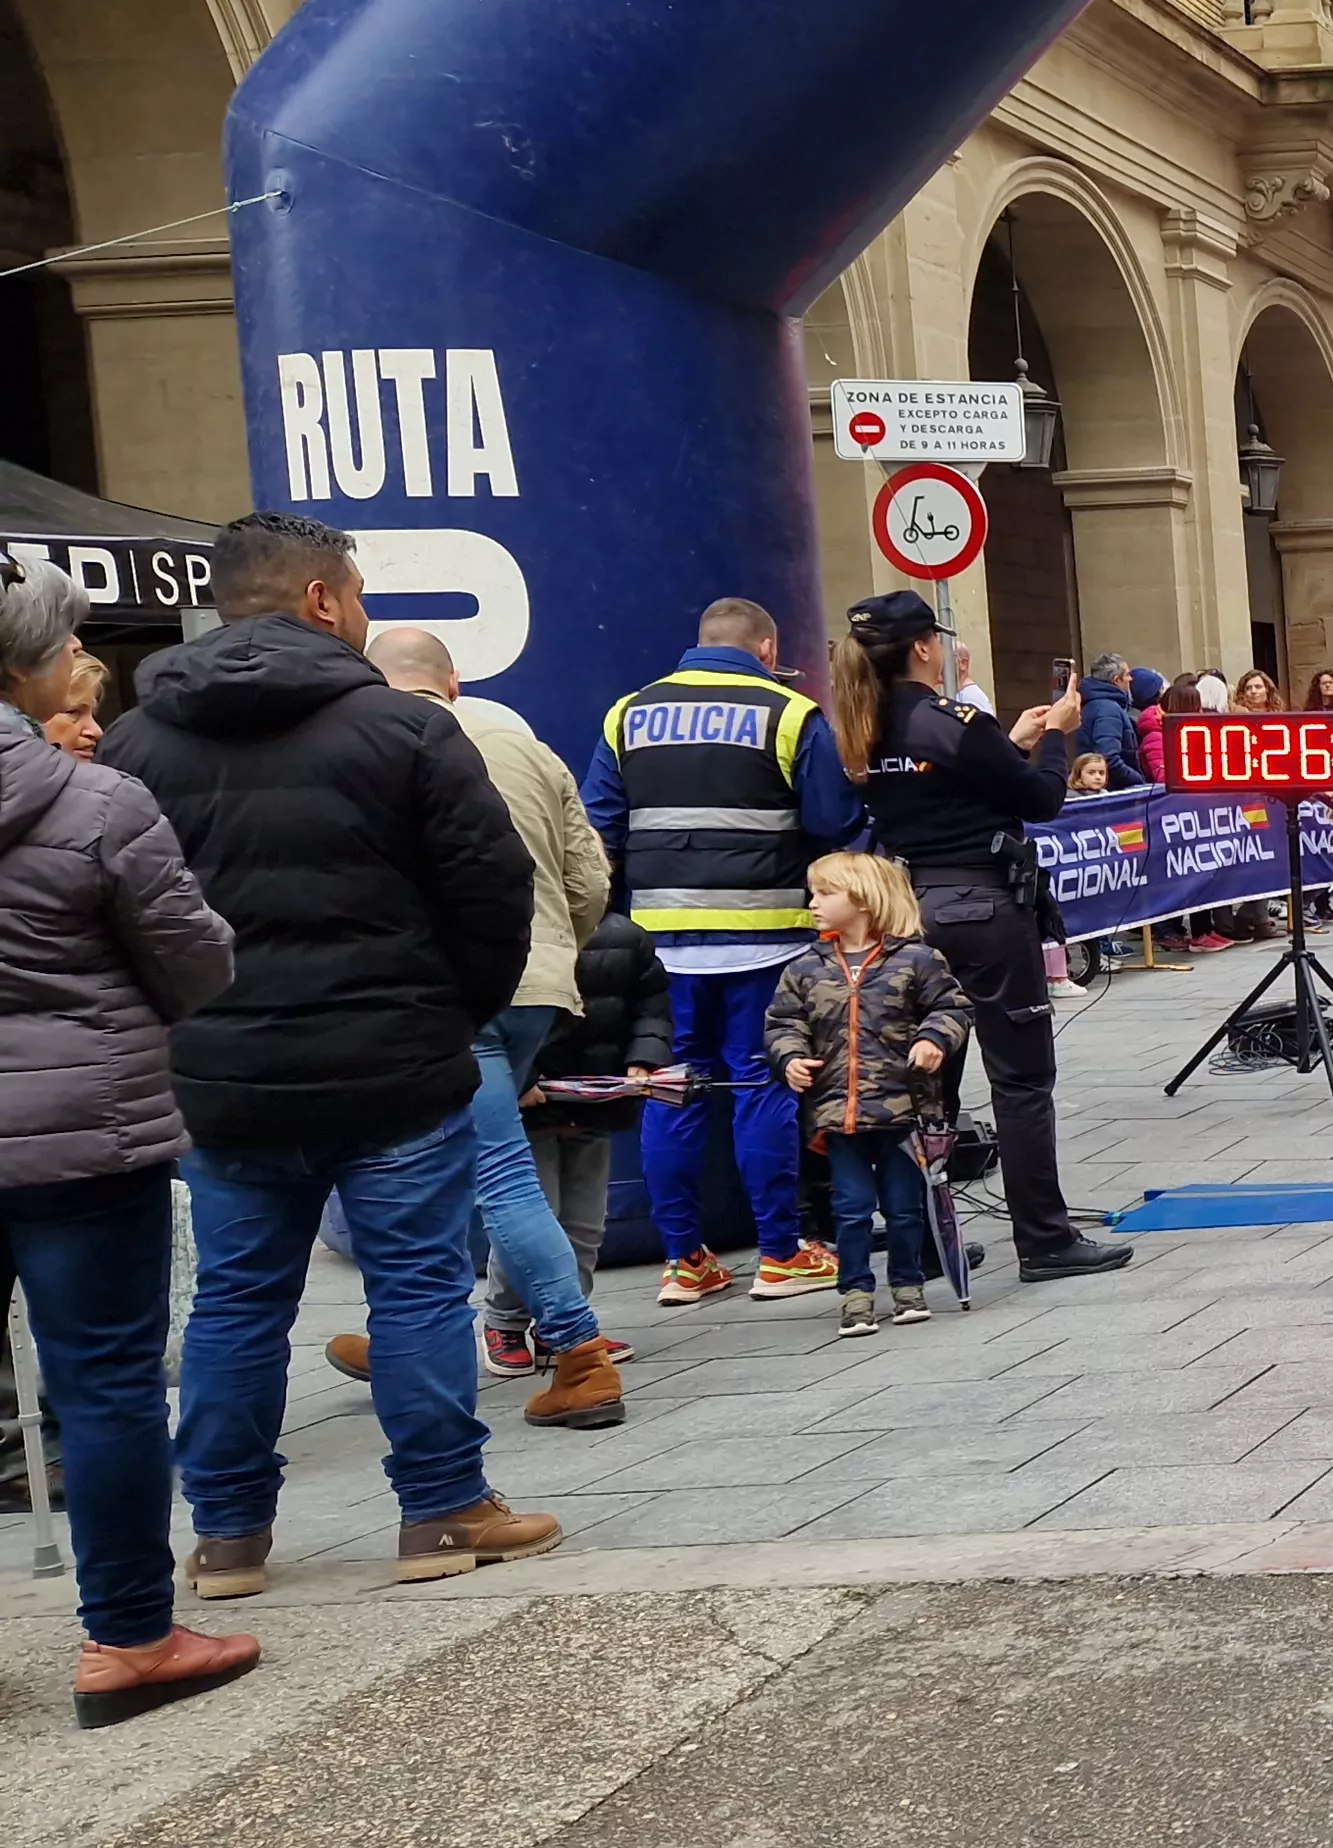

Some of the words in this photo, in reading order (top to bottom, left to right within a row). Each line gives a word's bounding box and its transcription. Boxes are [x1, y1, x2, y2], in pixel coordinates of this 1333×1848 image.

[847, 391, 892, 403] ZONA
[898, 393, 919, 404] DE
[925, 393, 1008, 405] ESTANCIA
[277, 348, 520, 501] RUTA
[898, 409, 958, 419] EXCEPTO
[963, 410, 1008, 420] CARGA
[900, 424, 907, 433] Y
[911, 424, 983, 434] DESCARGA
[900, 440, 916, 449] DE
[922, 441, 928, 449] 9
[934, 441, 942, 449] A
[946, 441, 956, 449] 11
[961, 441, 1006, 450] HORAS
[629, 705, 758, 746] POLICIA
[842, 756, 918, 780] LICIA
[1034, 826, 1124, 868] OLICiA
[1166, 834, 1275, 878] NACIONAL
